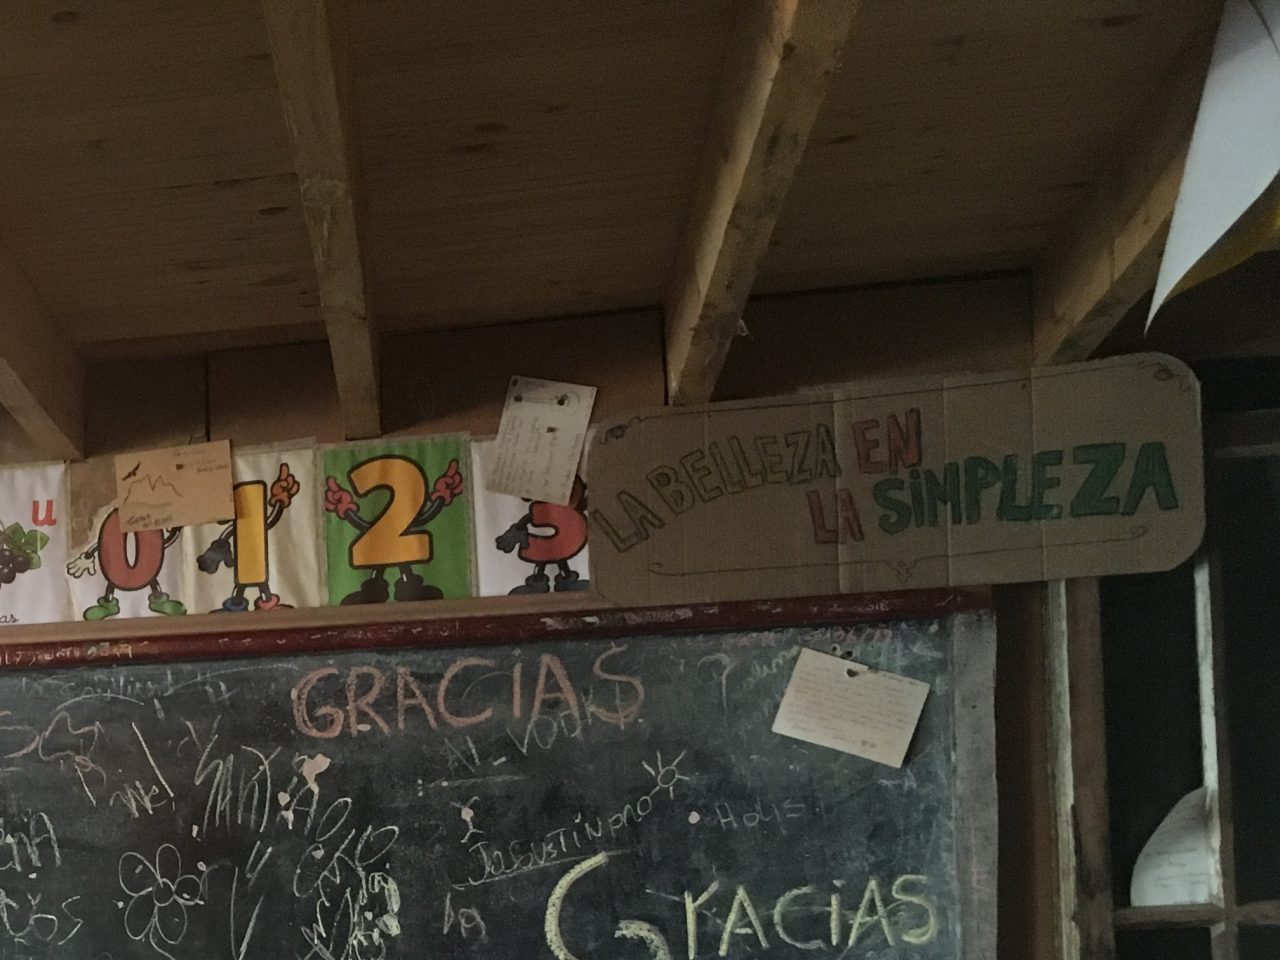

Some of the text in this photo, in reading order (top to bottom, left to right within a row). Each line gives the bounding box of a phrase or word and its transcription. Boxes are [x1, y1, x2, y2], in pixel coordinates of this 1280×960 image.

[348, 454, 434, 568] 2
[588, 490, 665, 554] LA
[646, 422, 844, 517] BELLEZA
[852, 408, 921, 475] EN
[807, 486, 865, 545] LA
[292, 643, 646, 740] GRACIAS
